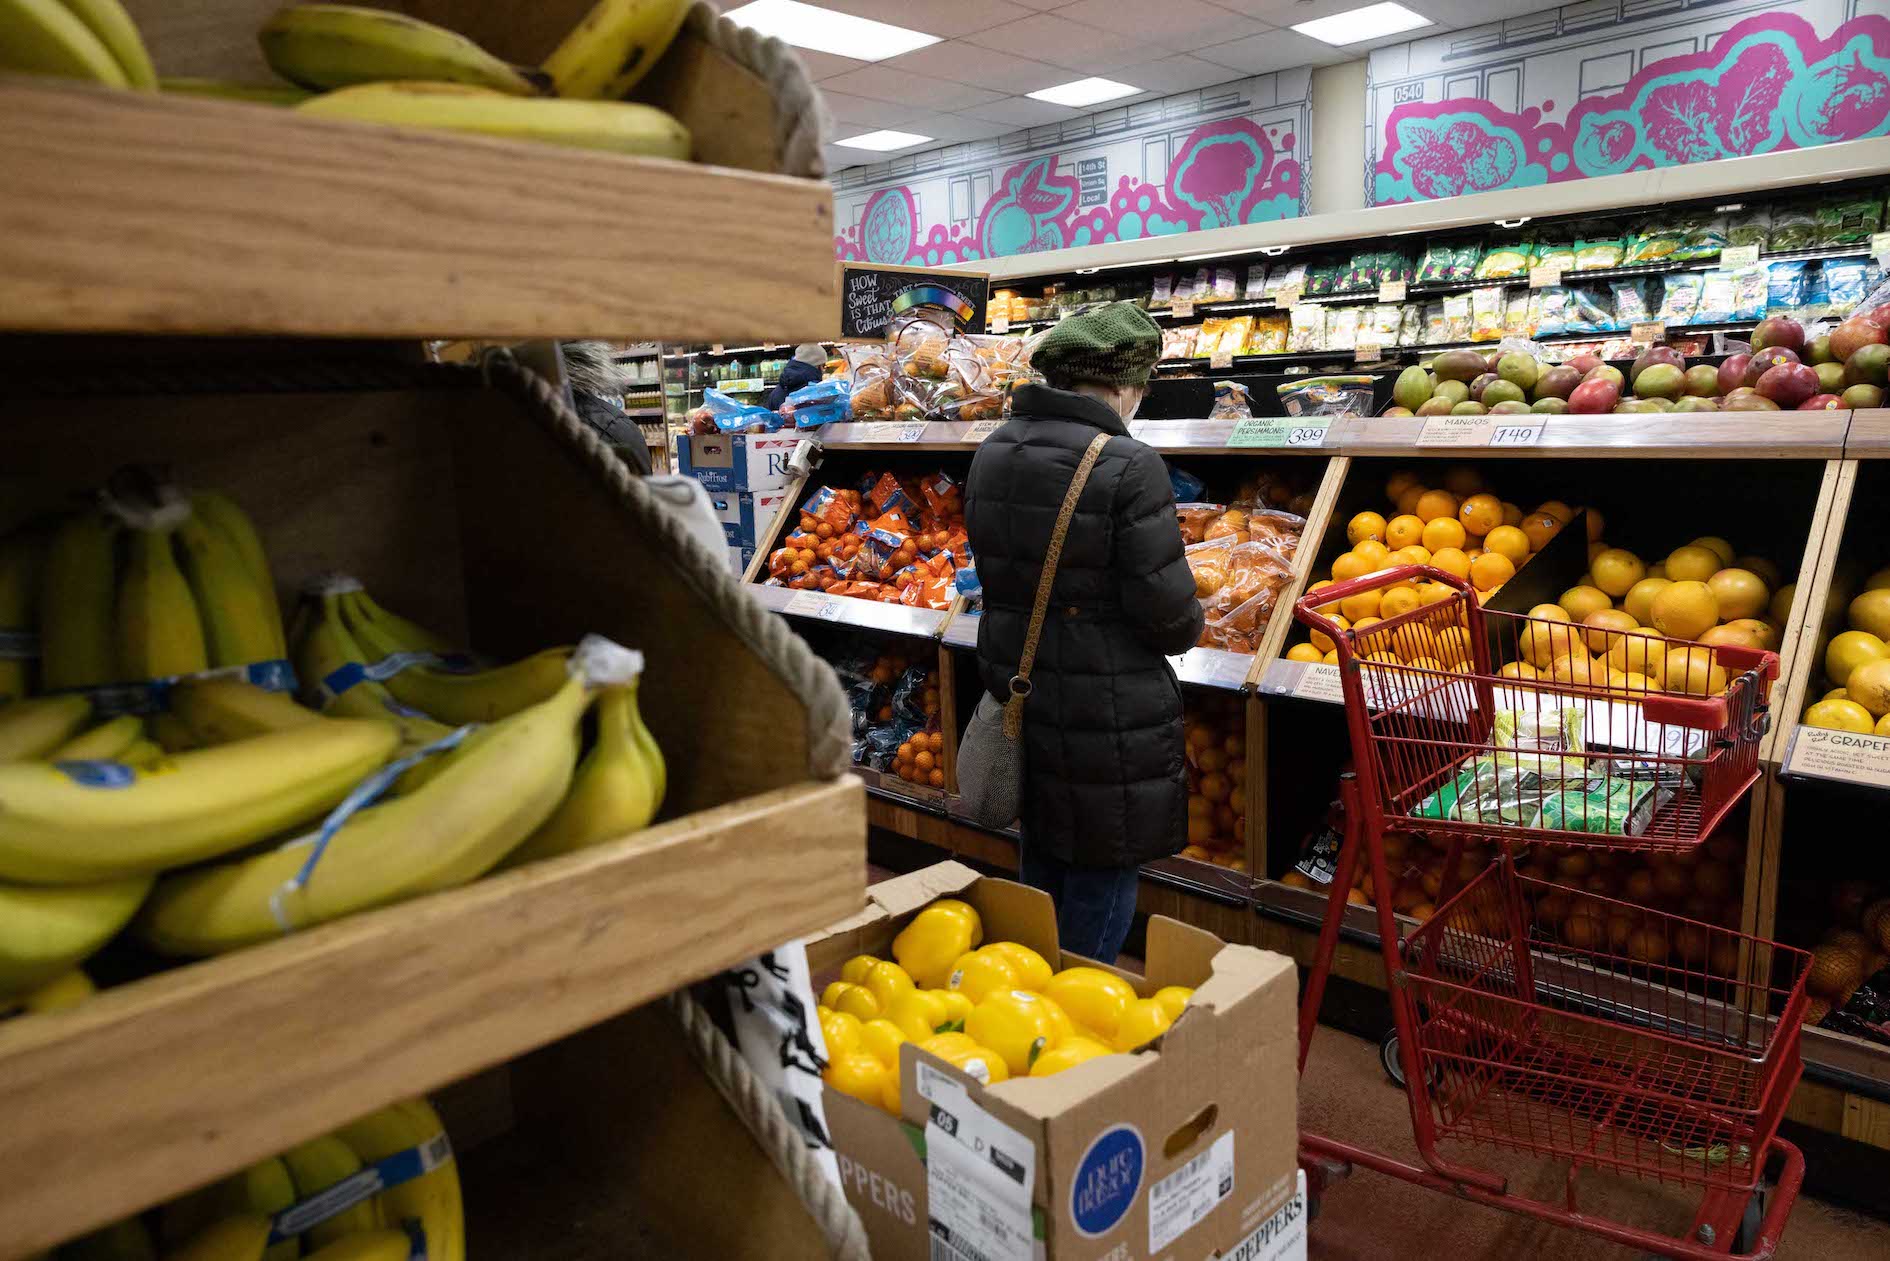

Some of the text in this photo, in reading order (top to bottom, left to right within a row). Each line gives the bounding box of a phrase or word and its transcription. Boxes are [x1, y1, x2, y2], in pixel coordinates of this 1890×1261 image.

[1395, 83, 1423, 102] 0540
[1082, 160, 1106, 171] 14th St
[1082, 193, 1101, 203] Local
[850, 273, 878, 291] HOW
[893, 284, 913, 298] TART
[848, 287, 880, 309] Sweet
[850, 299, 892, 320] IS THAT
[1243, 419, 1275, 427] ORGANIC
[1444, 418, 1490, 426] MANGOS
[1237, 427, 1285, 435] PERSIMMONS
[1807, 730, 1829, 738] Ruby
